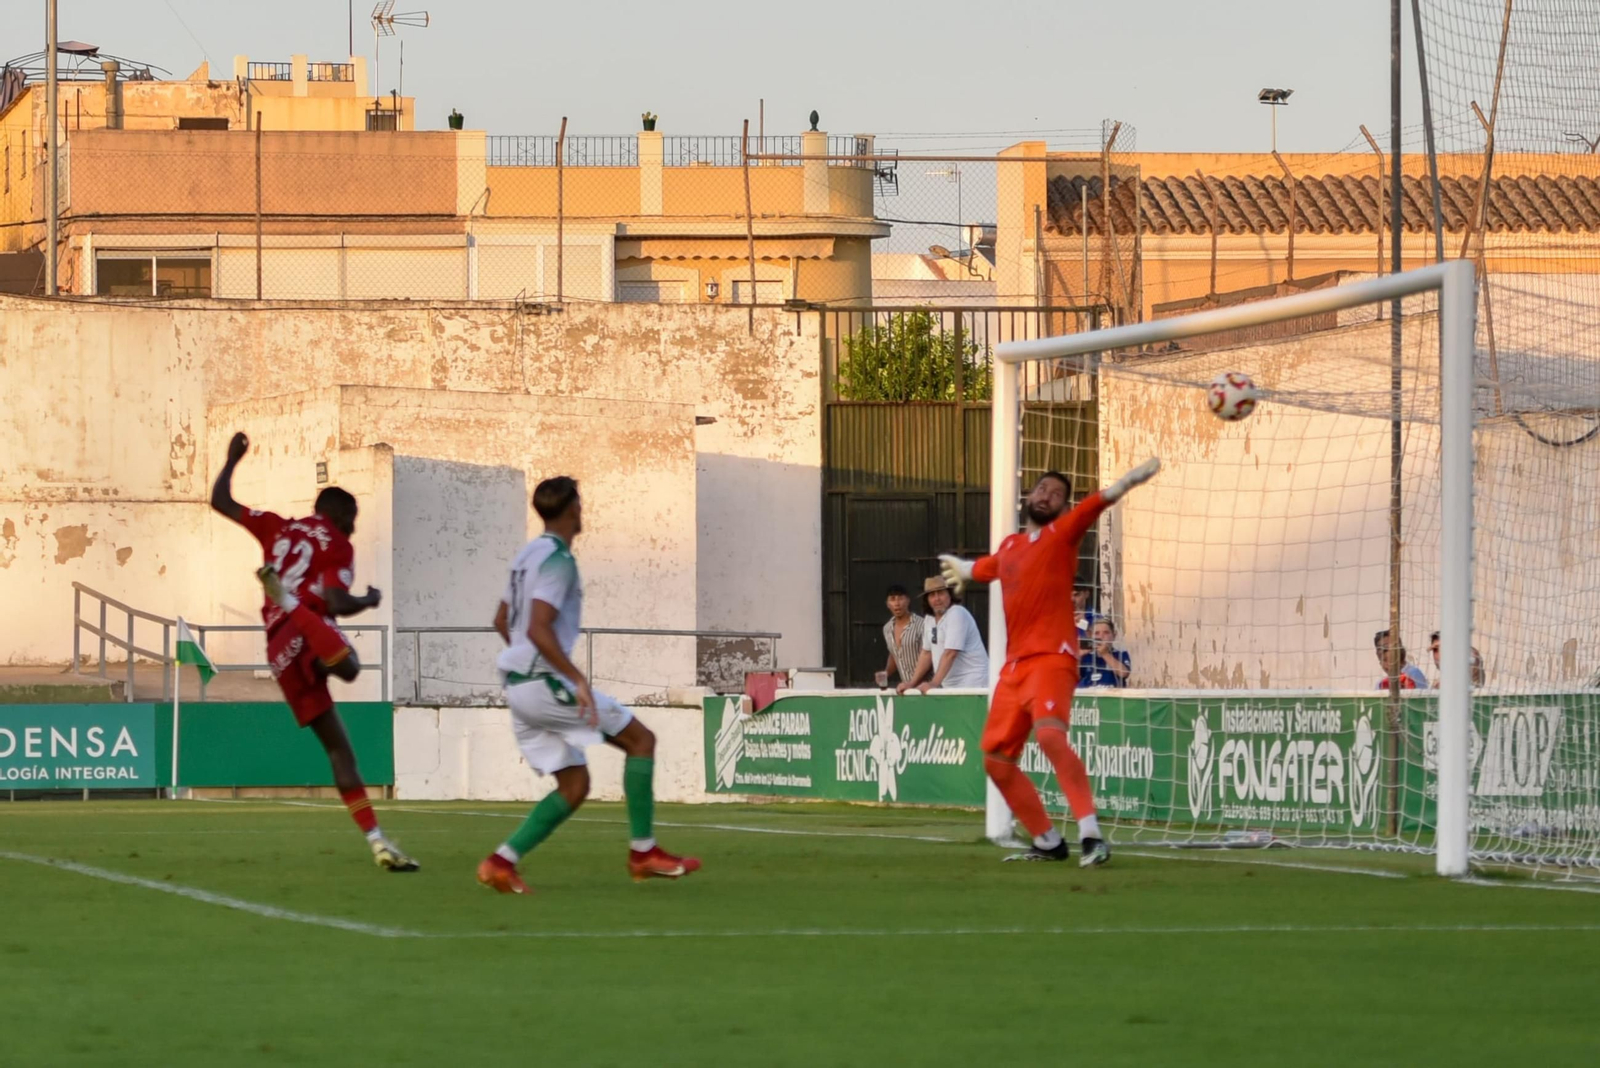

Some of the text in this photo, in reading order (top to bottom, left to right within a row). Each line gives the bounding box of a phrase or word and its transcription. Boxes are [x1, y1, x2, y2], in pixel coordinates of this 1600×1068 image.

[781, 712, 811, 735] PARADA
[849, 708, 878, 742] AGRO
[1070, 700, 1100, 726] afetería
[1221, 702, 1342, 741] Instalaciones y Servicios
[0, 726, 139, 758] DENSA
[835, 740, 879, 782] TÉCNICA
[896, 723, 967, 775] Sanlúcar
[1085, 731, 1154, 791] Espartero
[1493, 711, 1549, 788] TOP
[55, 766, 139, 780] INTEGRAL
[1219, 739, 1344, 804] FONGATER
